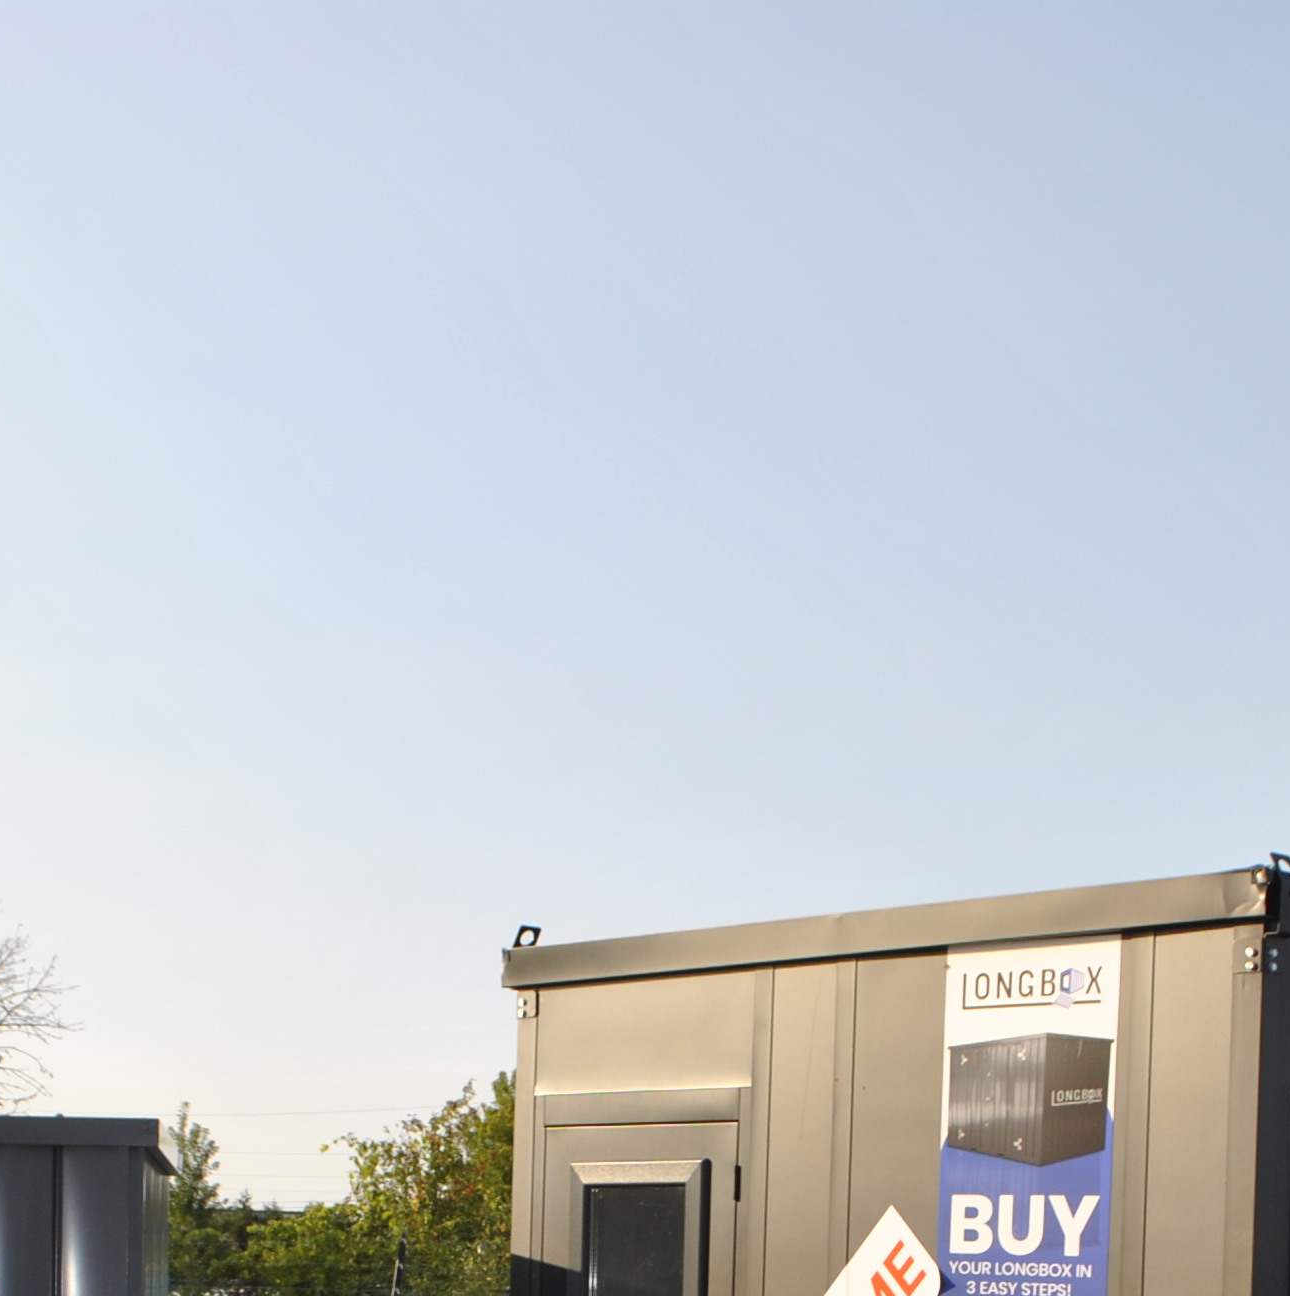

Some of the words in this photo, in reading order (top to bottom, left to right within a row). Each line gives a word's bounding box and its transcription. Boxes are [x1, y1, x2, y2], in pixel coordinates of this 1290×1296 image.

[962, 966, 1103, 1010] LONGBOX
[949, 1194, 1101, 1257] BUY
[949, 1261, 991, 1275] YOUR
[994, 1262, 1072, 1278] LONGBOX
[1076, 1264, 1092, 1278] IN
[966, 1281, 976, 1294] 3
[980, 1281, 1018, 1295] EASY
